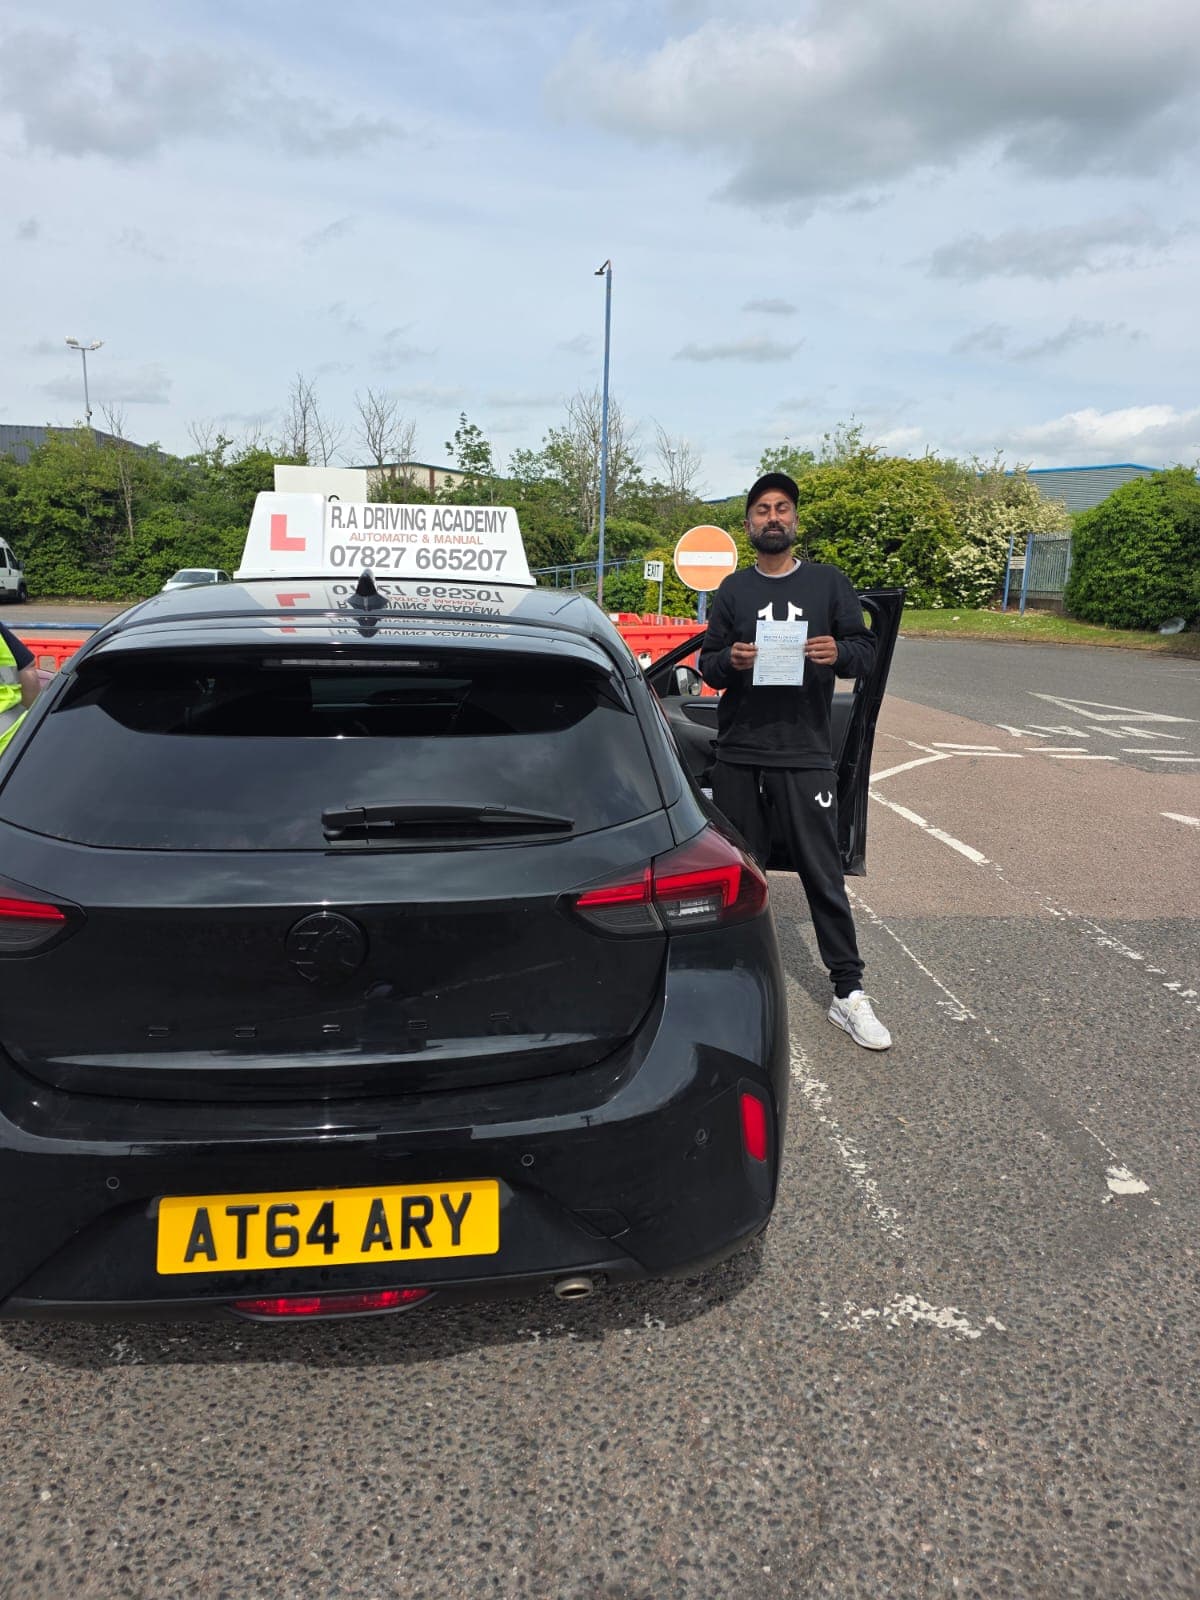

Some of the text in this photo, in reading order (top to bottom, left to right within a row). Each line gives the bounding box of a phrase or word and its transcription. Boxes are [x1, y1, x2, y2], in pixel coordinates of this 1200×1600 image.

[270, 513, 306, 551] L
[331, 505, 508, 533] R.A DRIVING ACADEMY
[349, 532, 484, 545] AUTOMATIC & MANUAL
[329, 545, 507, 572] 07827 665207
[647, 563, 660, 577] EXIT
[184, 1192, 472, 1262] AT64 ARY
